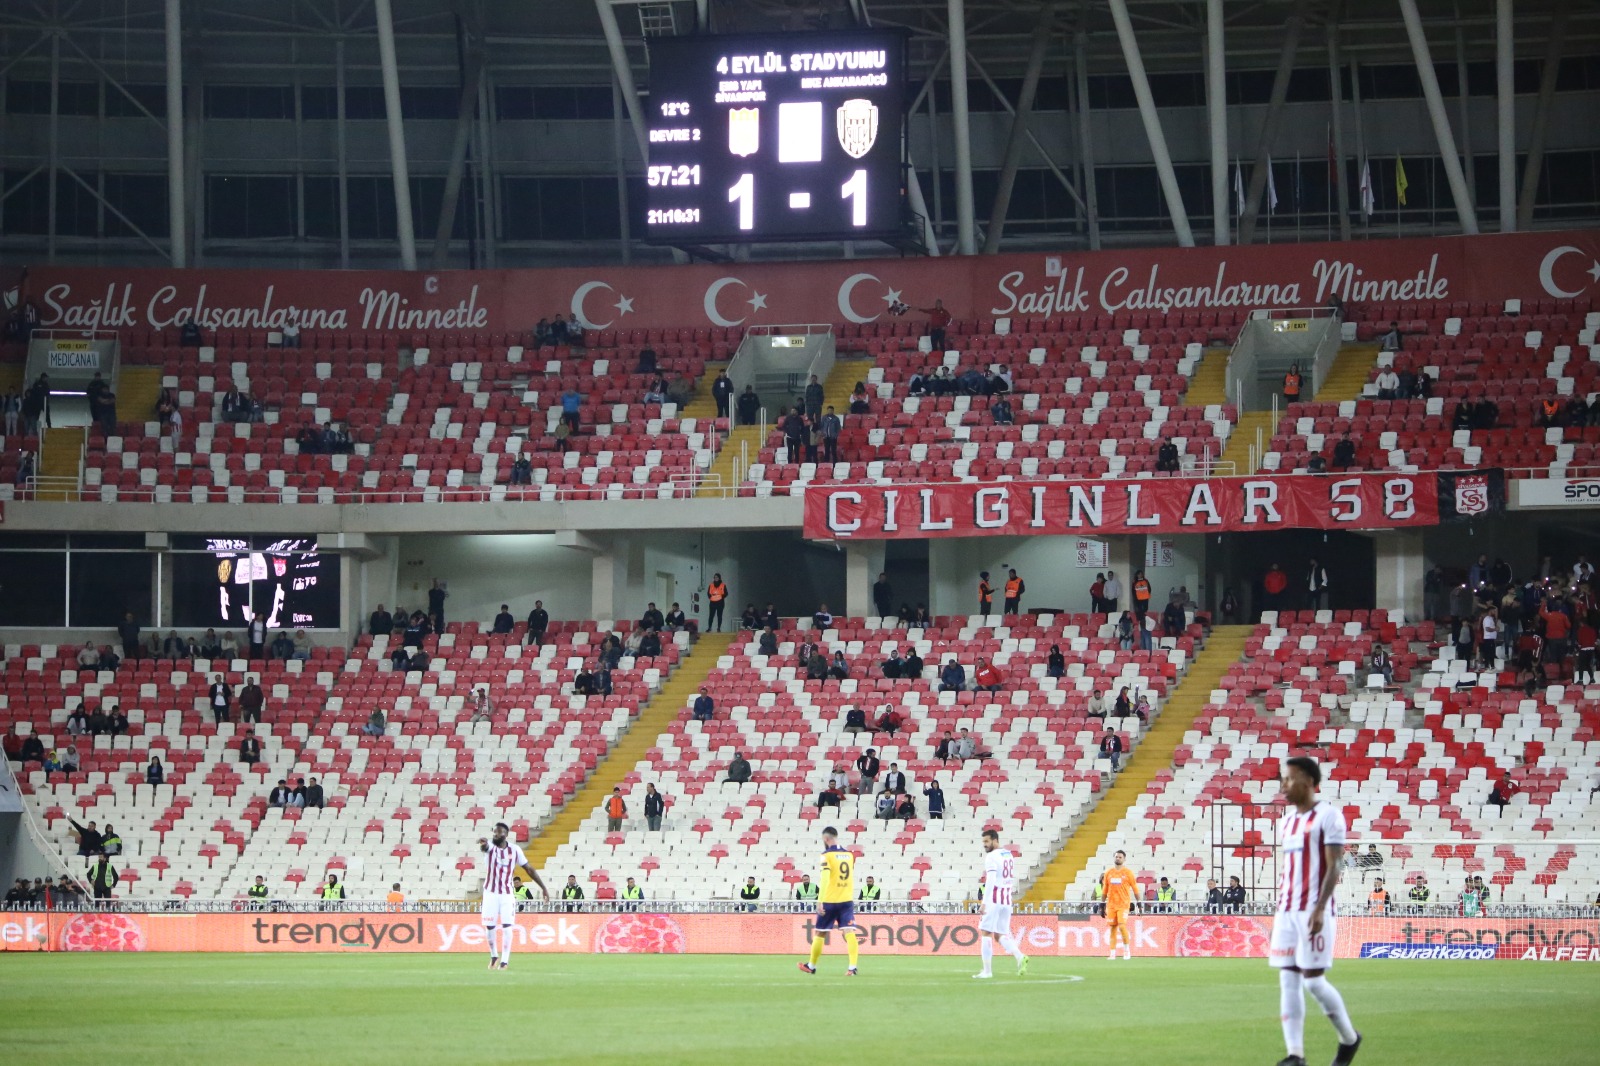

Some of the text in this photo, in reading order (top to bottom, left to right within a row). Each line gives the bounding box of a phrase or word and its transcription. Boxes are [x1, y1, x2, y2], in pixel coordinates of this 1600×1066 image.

[717, 50, 886, 74] 4 EYLÜL STADYUMU
[650, 128, 701, 142] DEVRE 2
[647, 165, 700, 186] 57:21
[729, 173, 754, 230] 1
[841, 169, 867, 227] 1
[425, 276, 438, 293] C
[991, 253, 1448, 319] Sağlık Çalışanlarına Minnetle
[40, 282, 487, 336] Sağlık Çalışanlarına Minnetle
[50, 352, 92, 367] MEDICANA
[1329, 477, 1416, 521] 58
[839, 861, 850, 881] 9
[252, 917, 423, 949] trendyol
[802, 917, 979, 951] trendyo
[1308, 934, 1325, 953] 10
